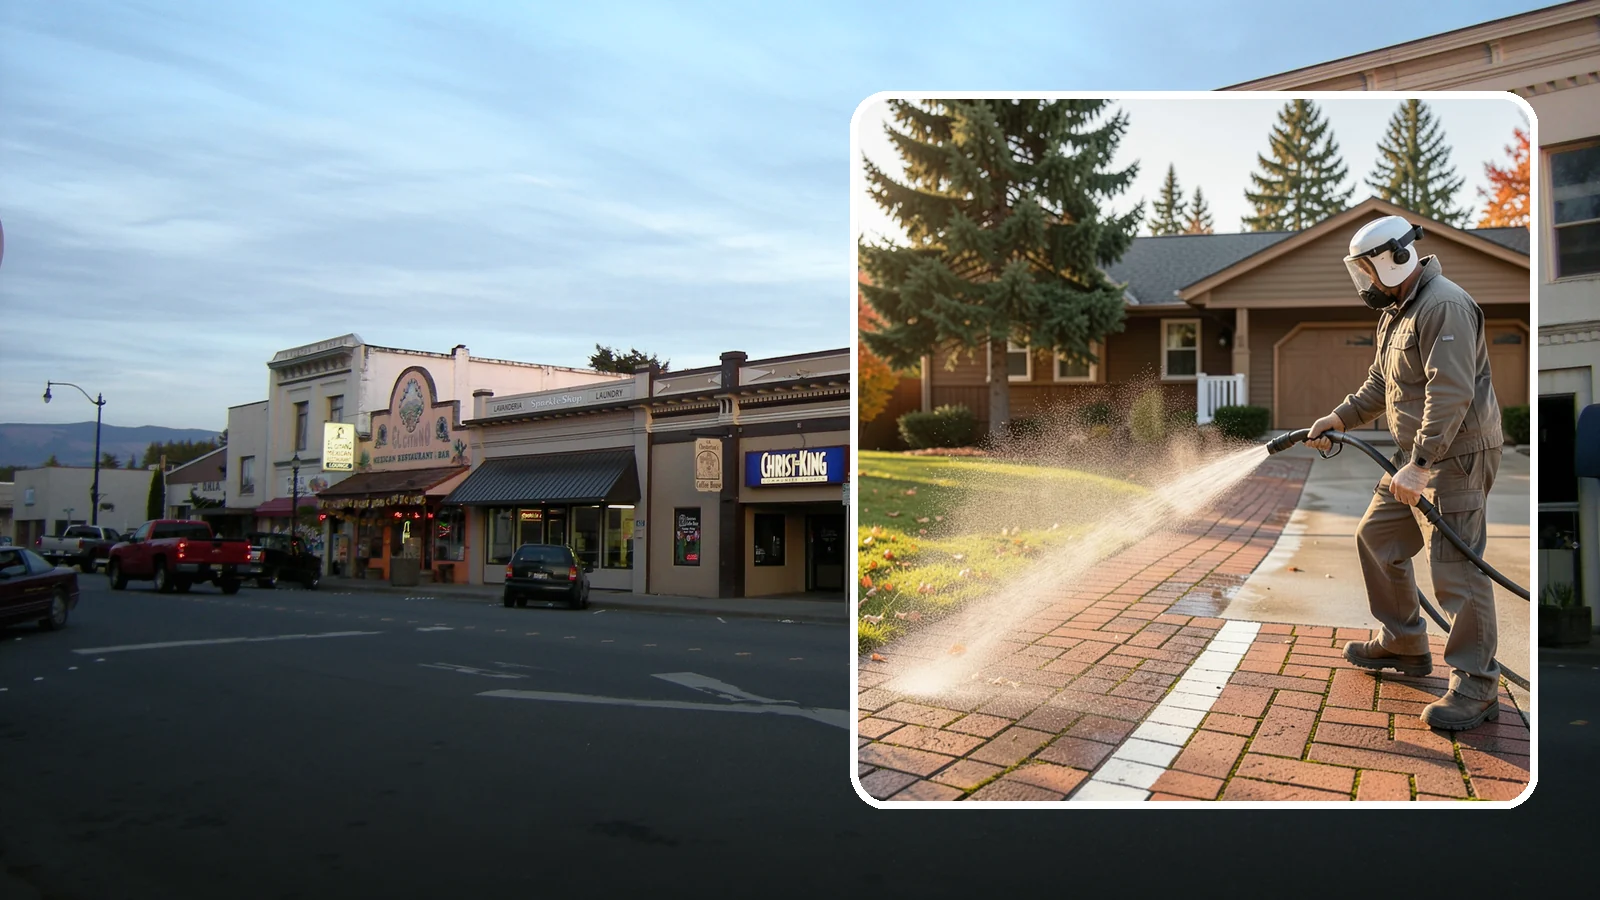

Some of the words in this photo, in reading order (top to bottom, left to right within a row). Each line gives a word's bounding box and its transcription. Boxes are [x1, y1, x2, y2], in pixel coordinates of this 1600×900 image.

[493, 402, 522, 413] LAVANDERIA
[530, 397, 562, 409] Sparkle
[561, 394, 582, 405] Shop
[595, 389, 624, 400] LAUNDRY
[373, 455, 396, 464] MEXICAN
[397, 451, 433, 462] RESTAURANT
[437, 450, 450, 458] BAR
[760, 452, 797, 478] CHRIST
[799, 450, 827, 476] KING
